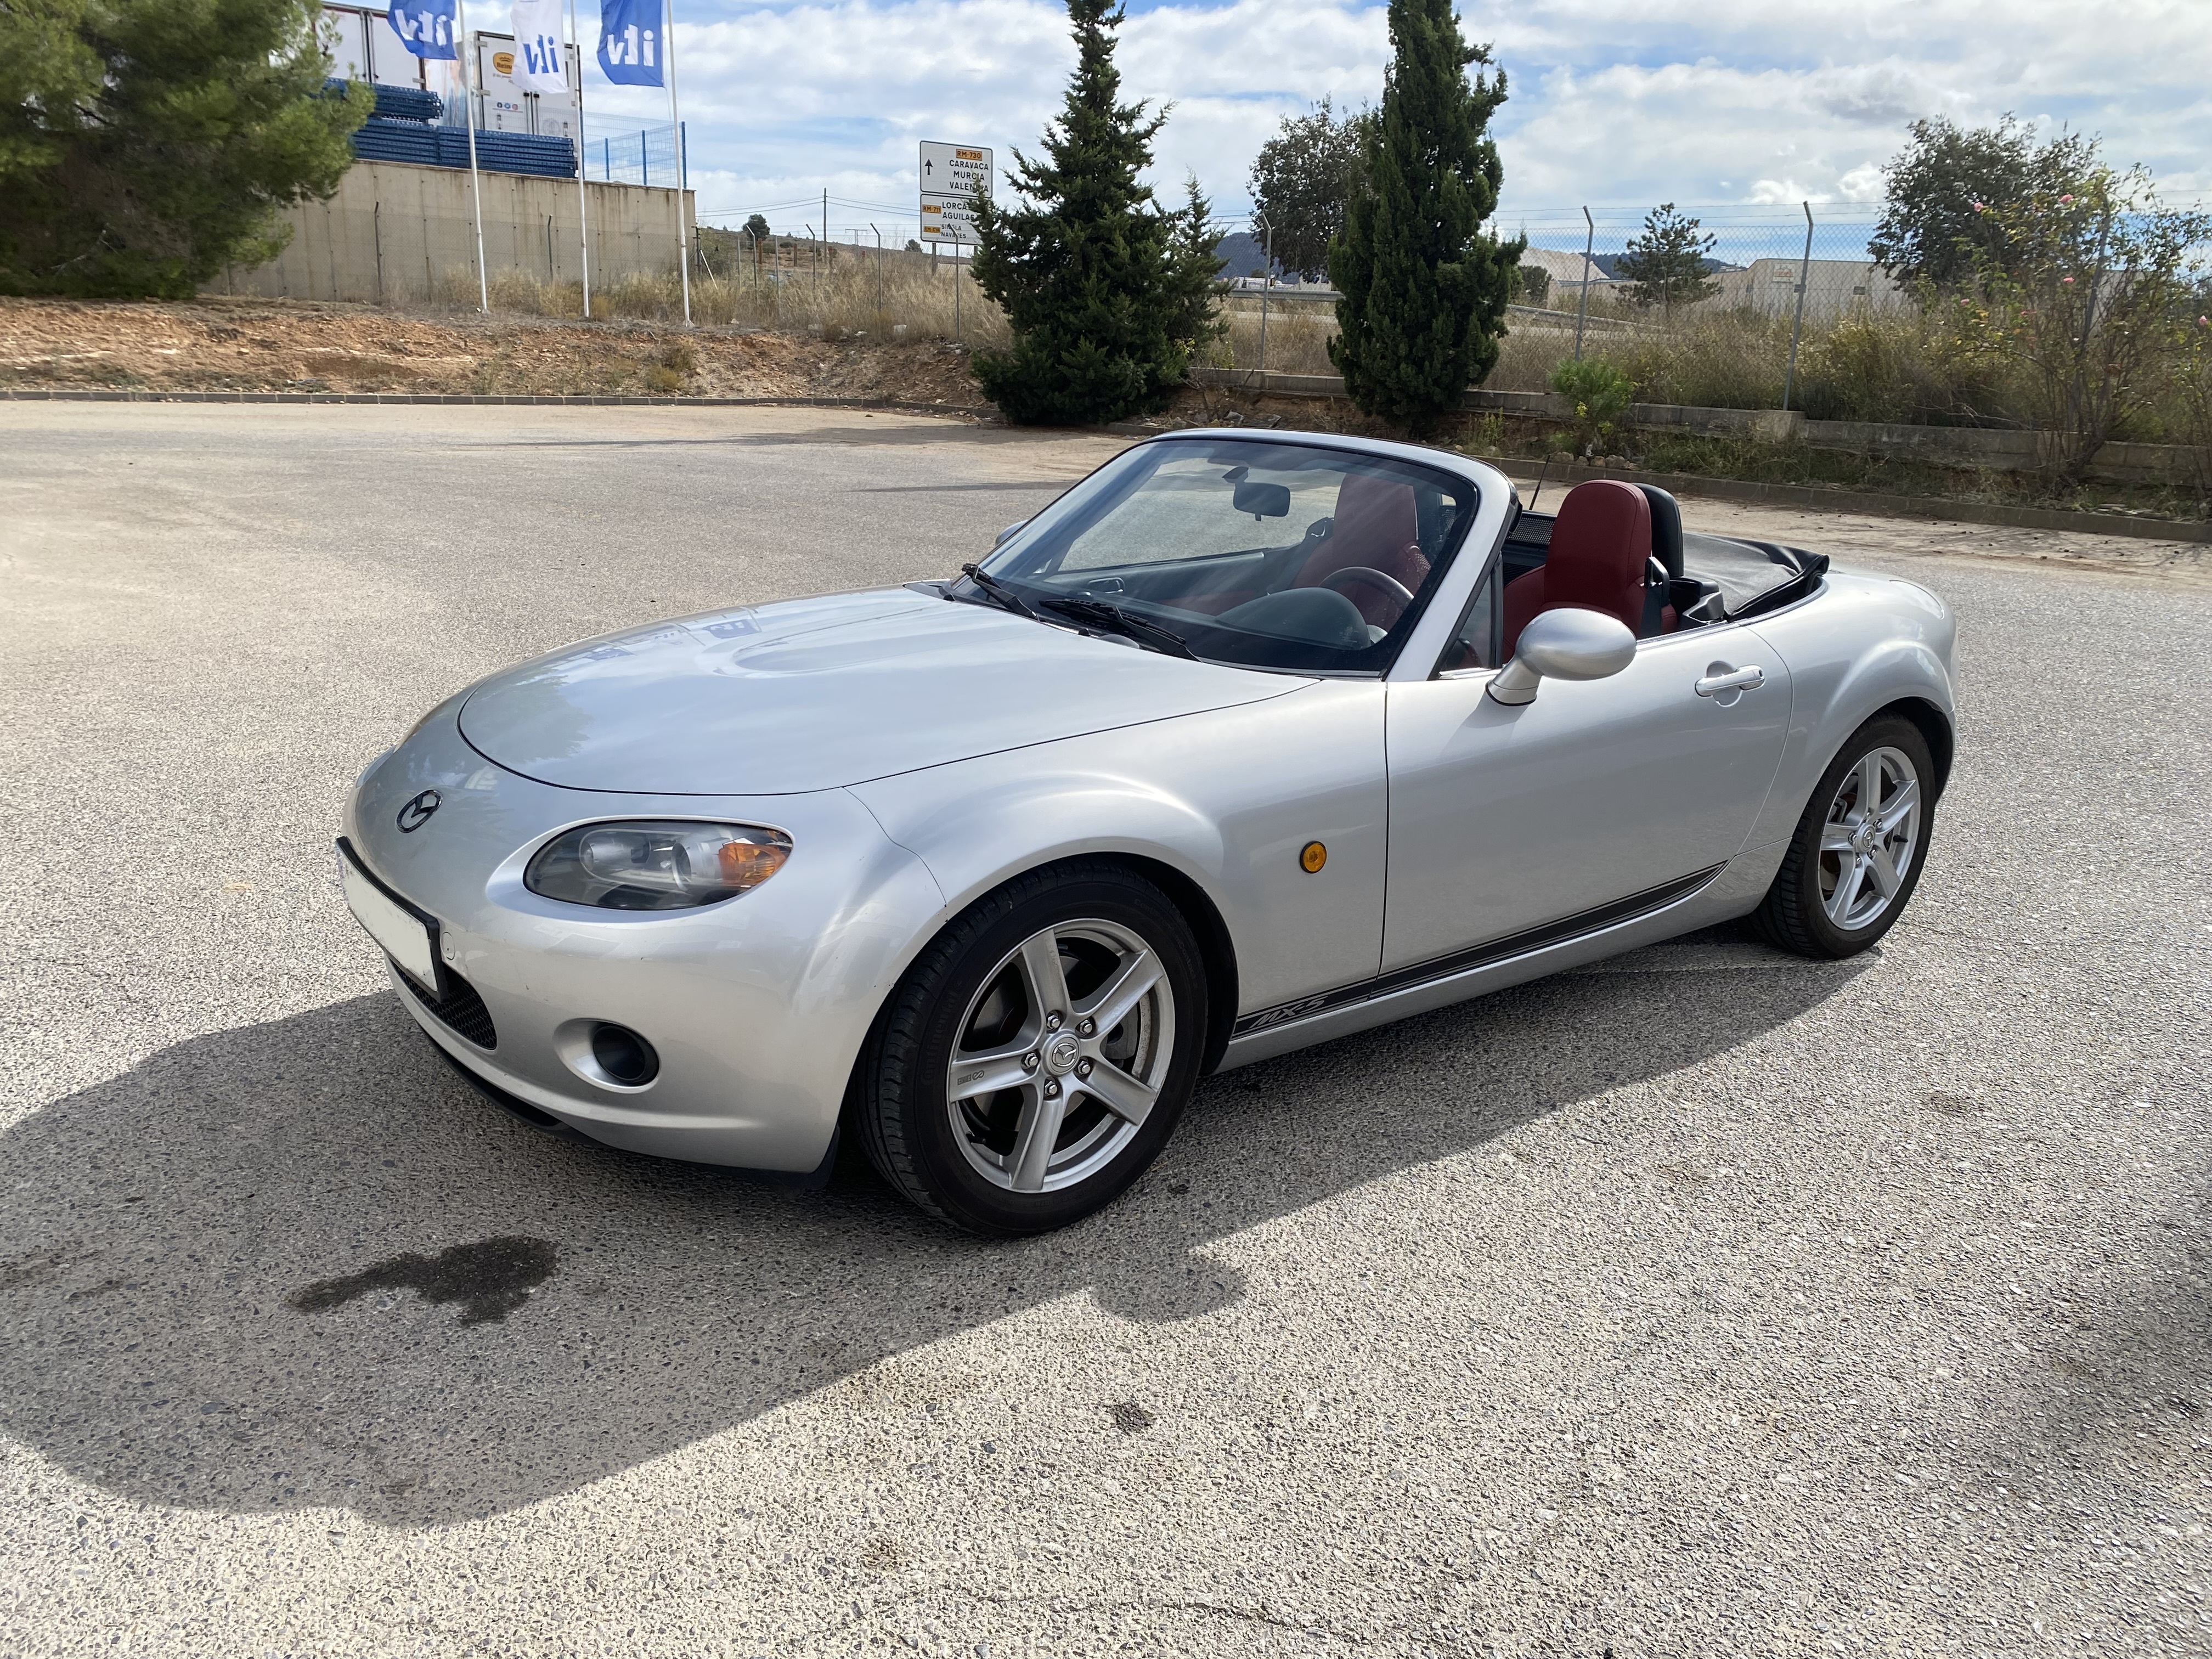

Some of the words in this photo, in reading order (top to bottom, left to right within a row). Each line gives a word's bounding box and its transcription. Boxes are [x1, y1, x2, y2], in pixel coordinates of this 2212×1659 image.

[957, 150, 981, 159] RM-730
[949, 159, 989, 171] CARAVACA
[949, 181, 989, 193] VALENA
[942, 201, 967, 210] LORCA
